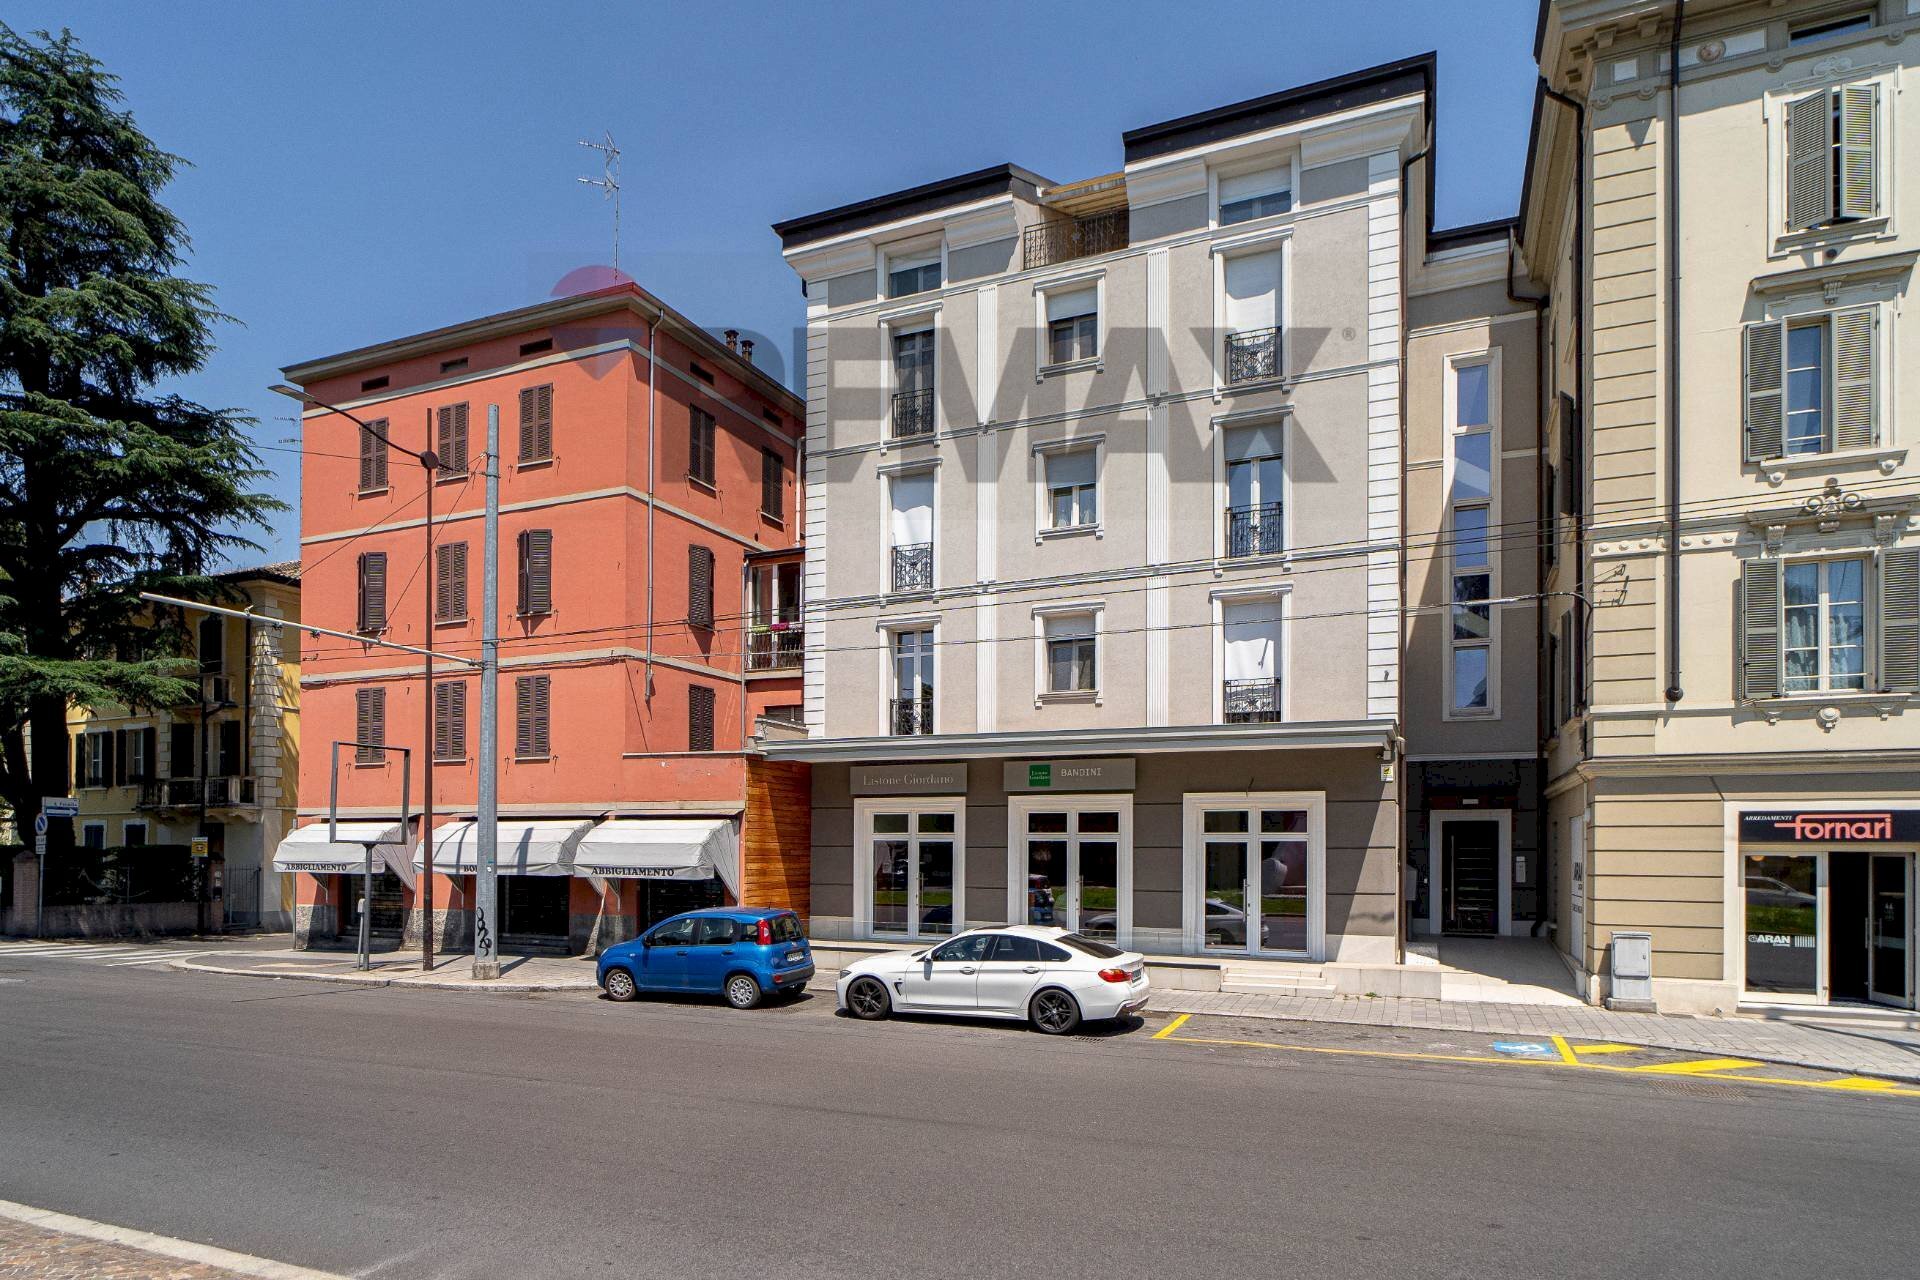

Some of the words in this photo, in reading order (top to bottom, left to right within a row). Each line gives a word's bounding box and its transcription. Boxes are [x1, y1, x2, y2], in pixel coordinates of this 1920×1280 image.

[1061, 768, 1102, 777] BANDINI
[863, 775, 901, 786] Listone
[903, 773, 954, 785] Giordano
[285, 863, 347, 871] ABBIGLIAMENTO
[591, 866, 675, 876] ABBIGLIAMENTO
